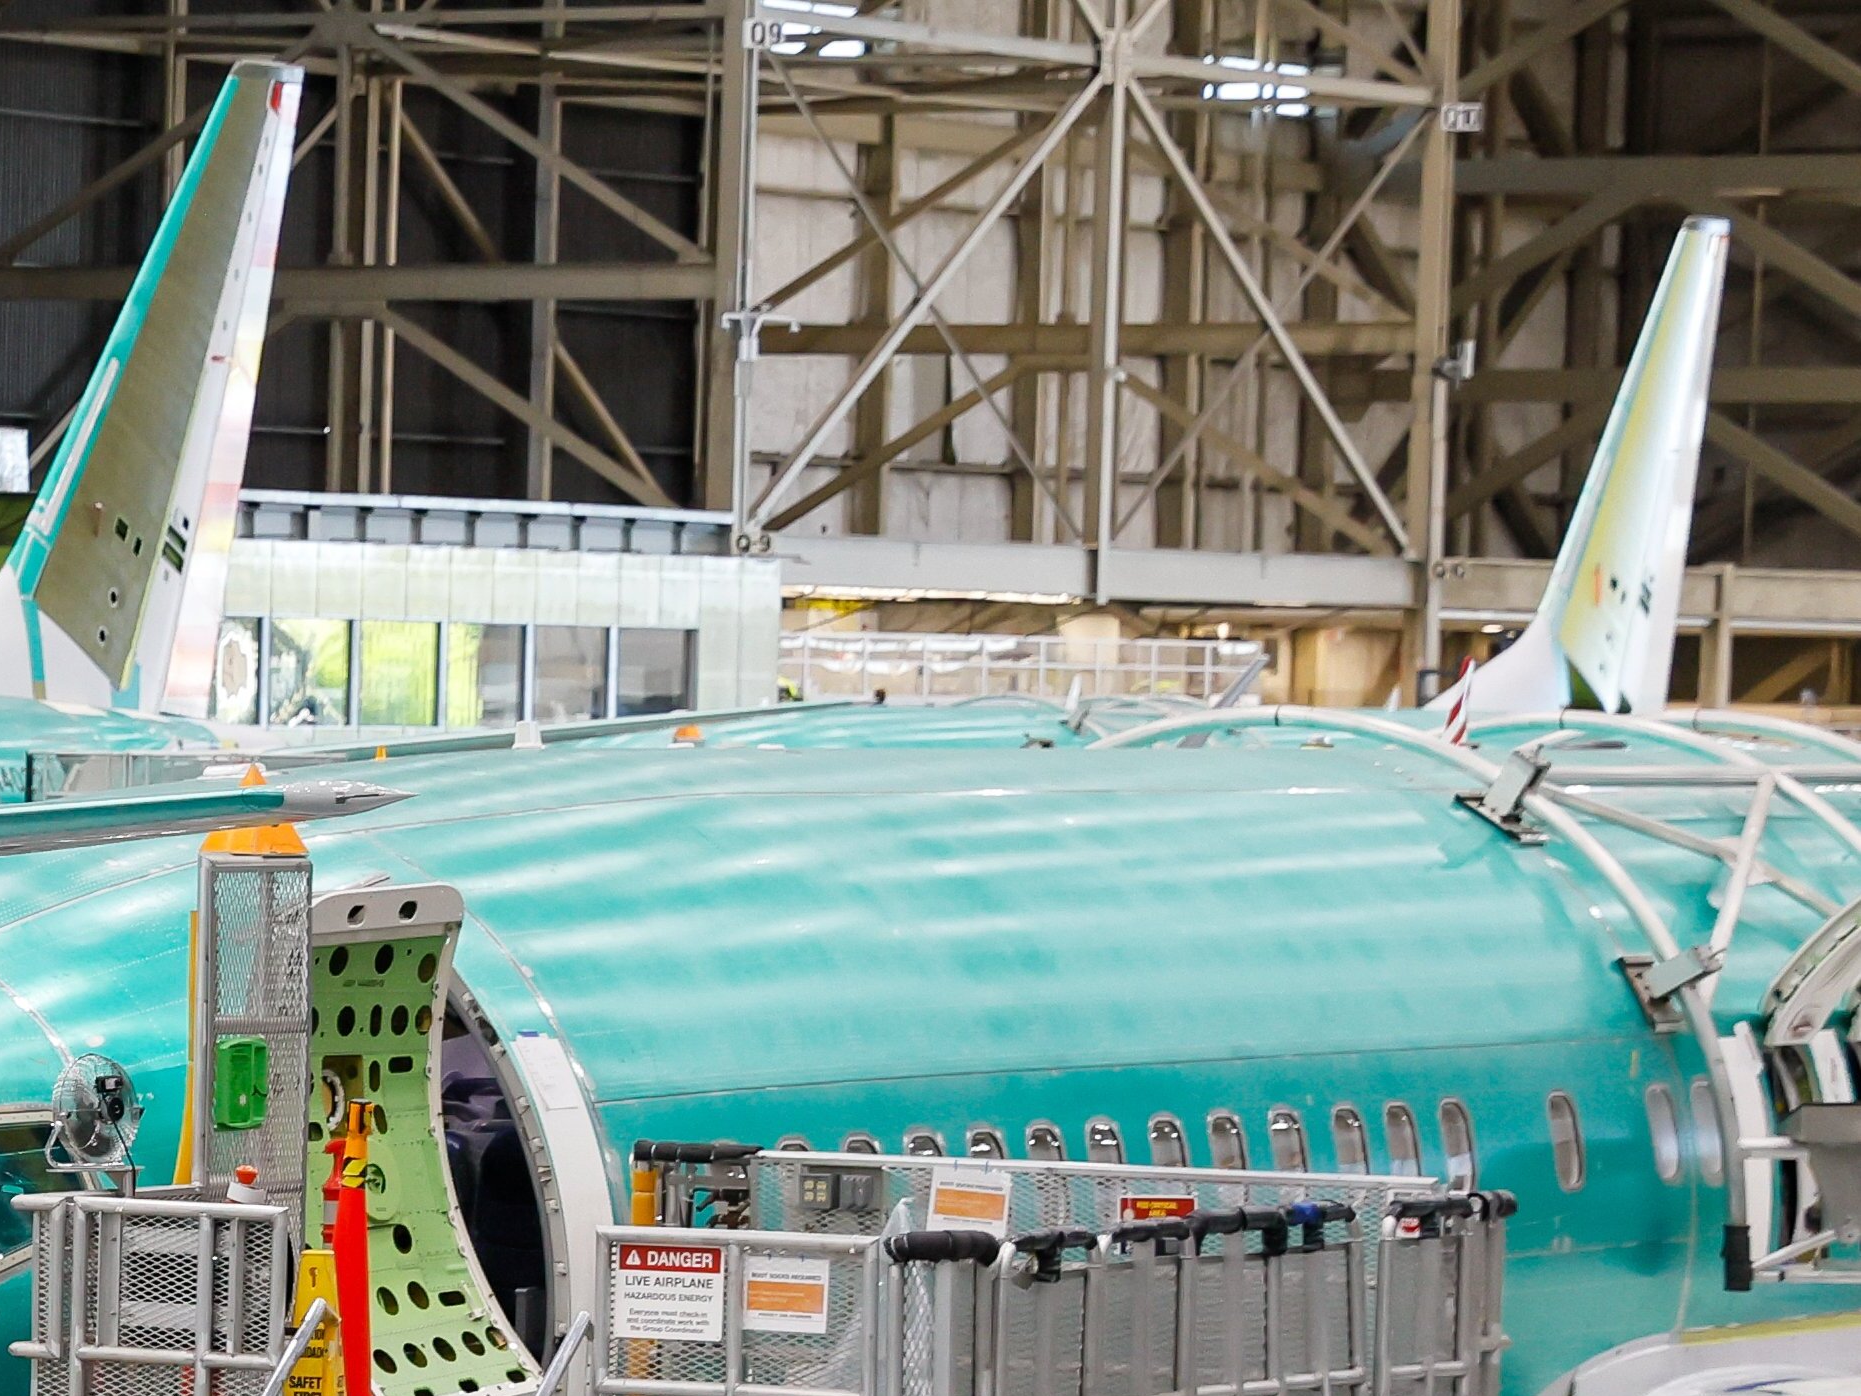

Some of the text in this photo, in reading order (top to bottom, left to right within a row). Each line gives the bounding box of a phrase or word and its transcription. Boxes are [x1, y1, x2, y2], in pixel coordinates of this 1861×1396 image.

[646, 1250, 713, 1268] DANGER
[625, 1275, 714, 1289] LIVE AIRPLANE
[624, 1291, 713, 1303] HAZARDOUS ENERGY
[289, 1376, 322, 1389] SAFET
